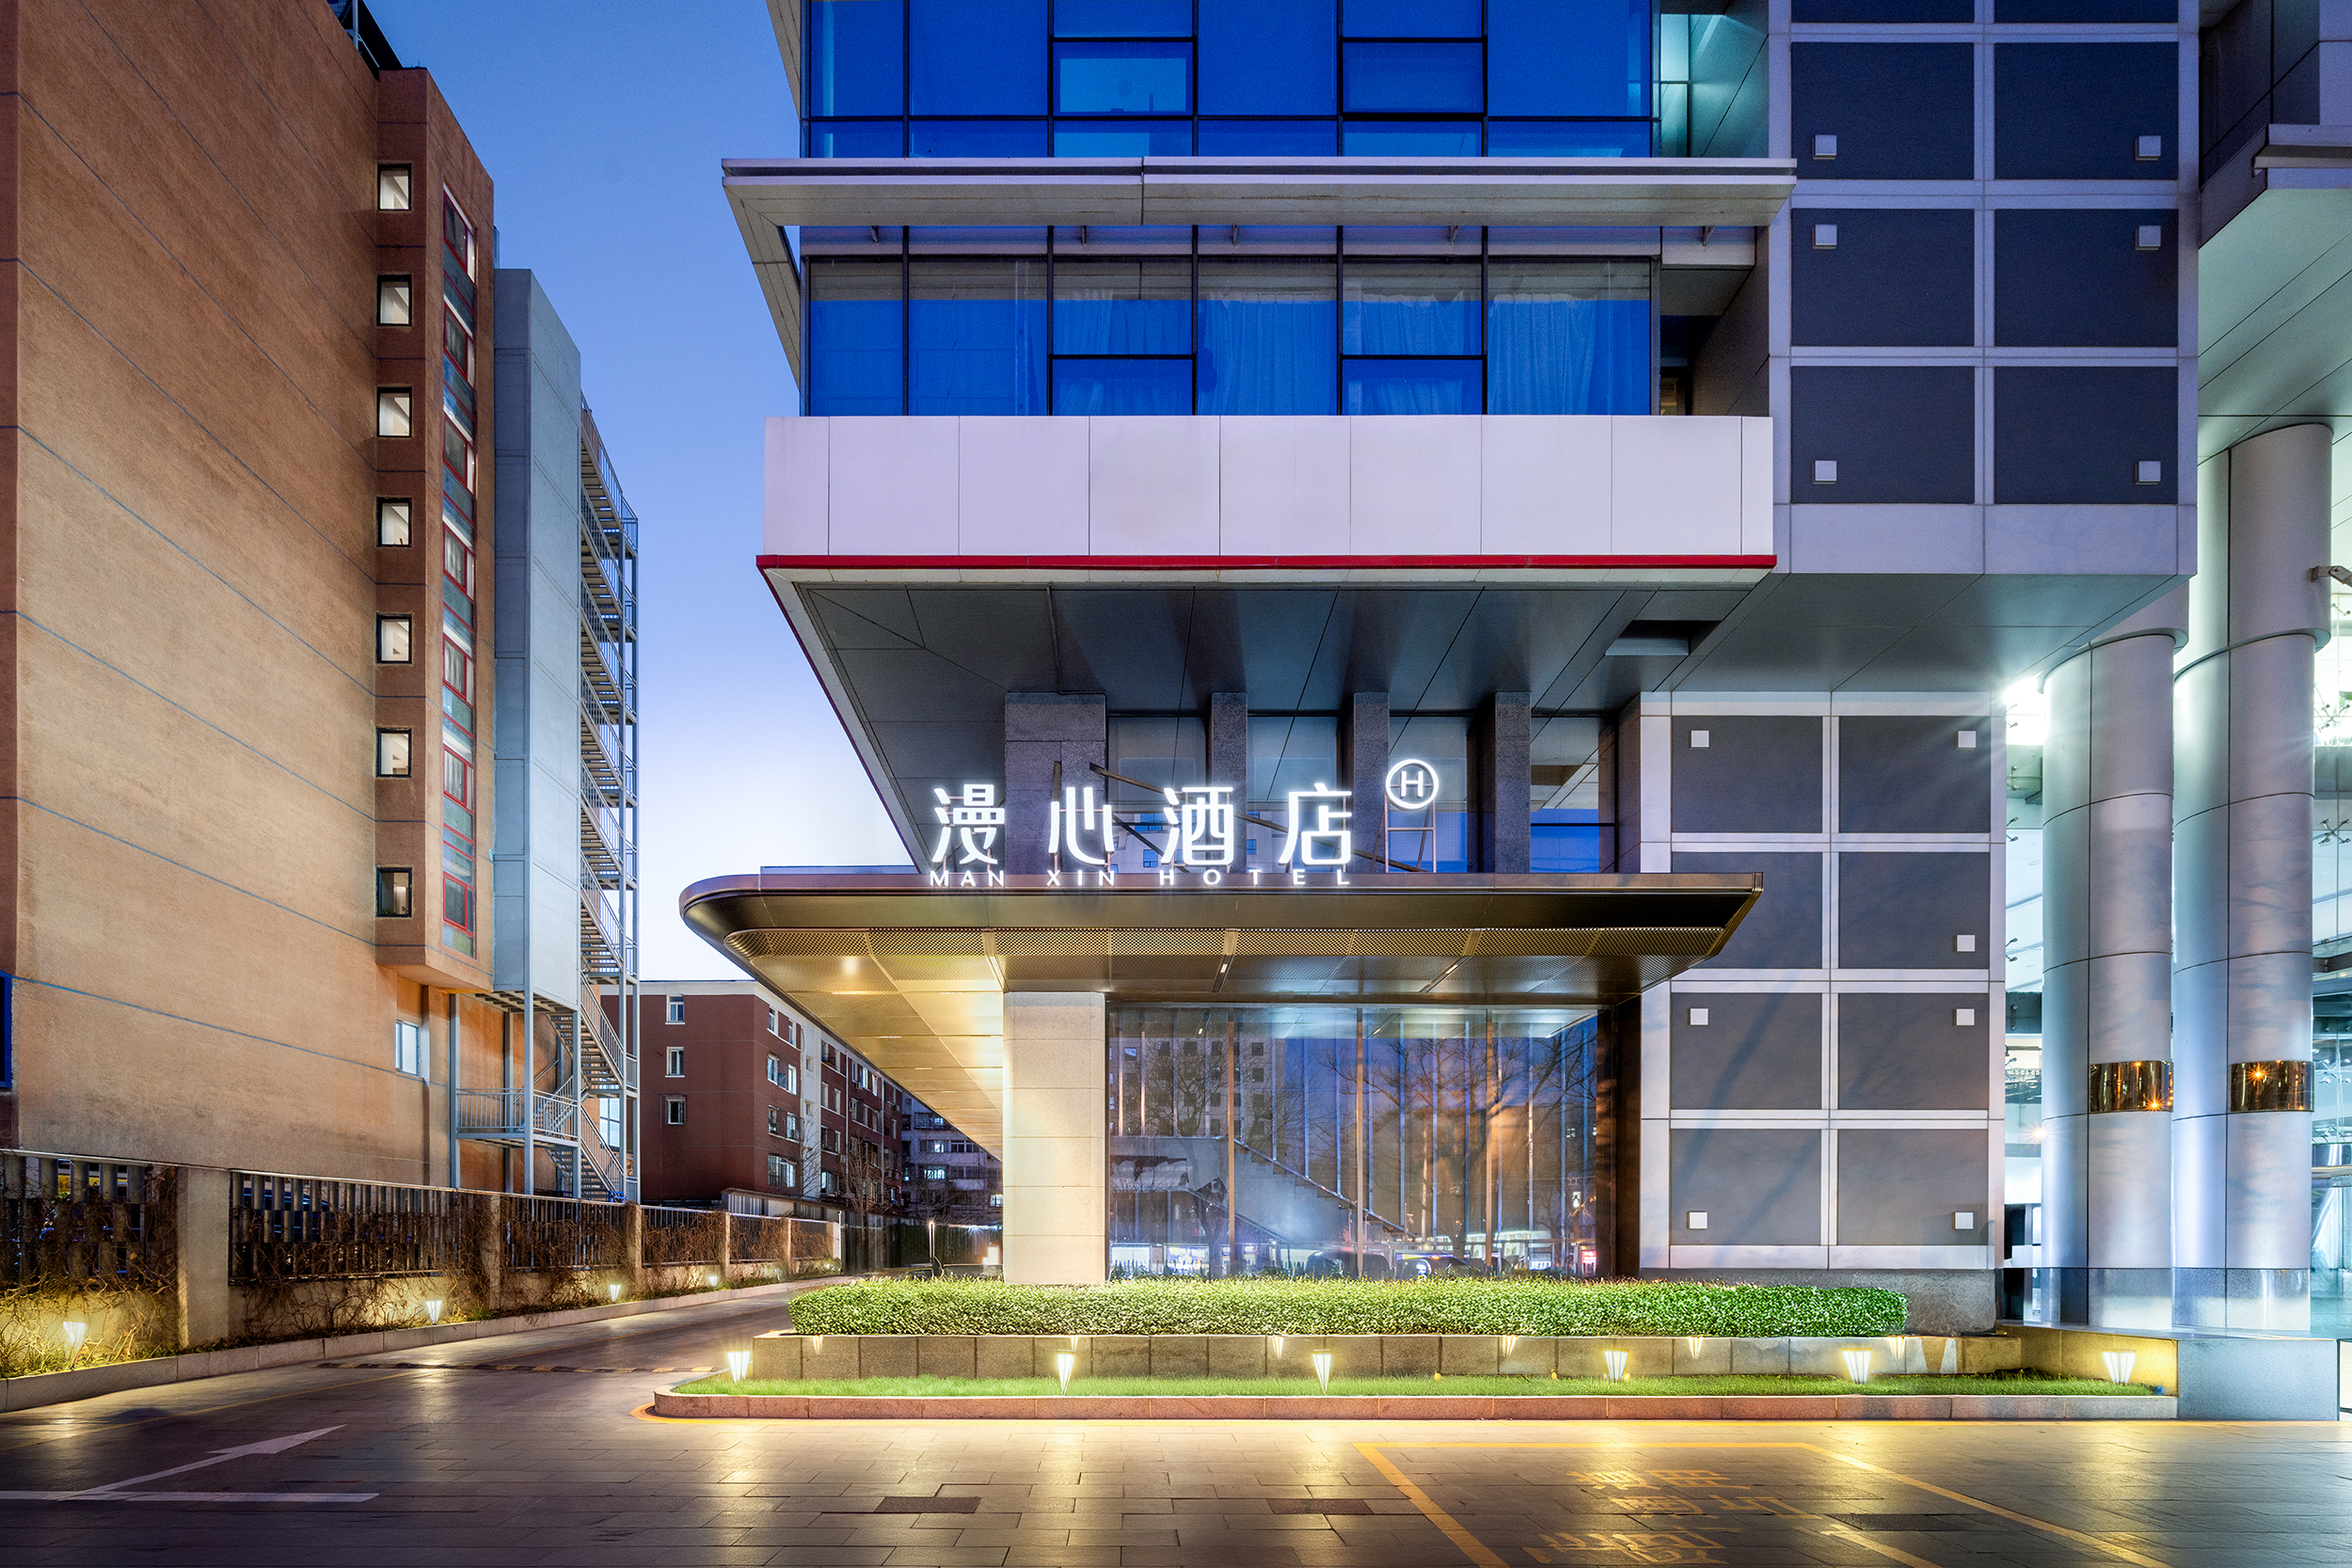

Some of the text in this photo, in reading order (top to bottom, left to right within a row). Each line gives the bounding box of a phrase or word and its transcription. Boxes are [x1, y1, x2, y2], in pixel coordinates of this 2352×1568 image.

[932, 783, 1353, 865] 漫心酒店
[930, 870, 1350, 887] MAN XIN HOTEL
